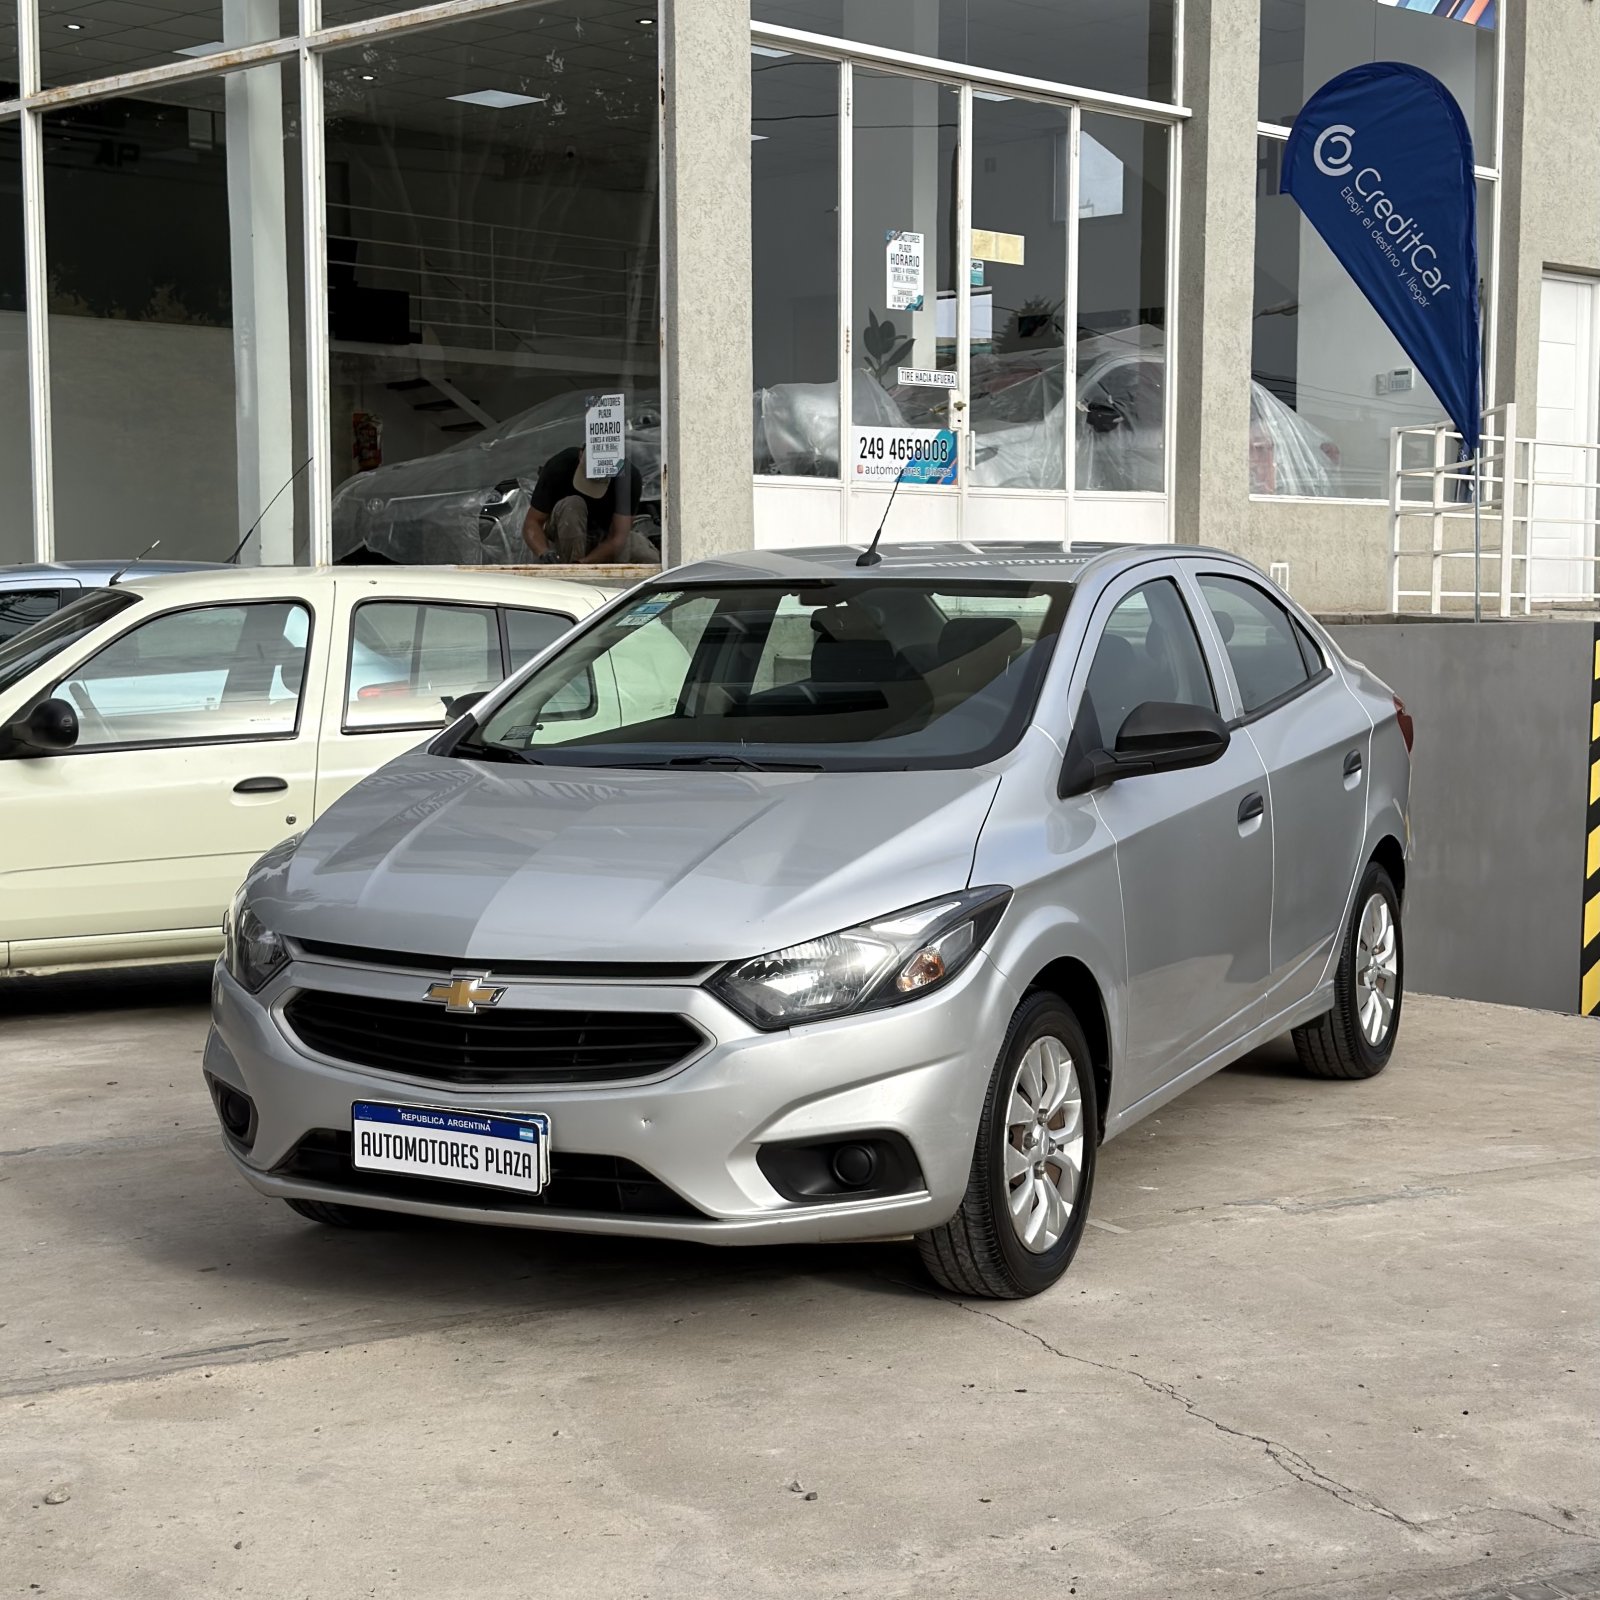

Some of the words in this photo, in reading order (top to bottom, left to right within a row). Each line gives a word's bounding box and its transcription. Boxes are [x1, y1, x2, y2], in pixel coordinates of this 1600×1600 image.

[1355, 168, 1451, 296] CreditCar
[1340, 186, 1364, 216] Elegir
[1362, 217, 1375, 229] el
[1371, 230, 1400, 268] destino
[1398, 268, 1408, 277] y
[1406, 276, 1430, 308] llegar
[890, 253, 920, 267] HORARIO
[901, 371, 914, 381] TIRE
[915, 372, 932, 382] HACIA
[933, 374, 955, 384] AFUERA
[590, 421, 620, 435] HORARIO
[860, 437, 884, 459] 249
[889, 438, 948, 461] 4658008
[401, 1112, 445, 1126] REPUBLICA
[447, 1118, 491, 1132] ARGENTINA
[361, 1131, 479, 1170] AUTOMOTORES
[485, 1147, 532, 1179] PLAZA
